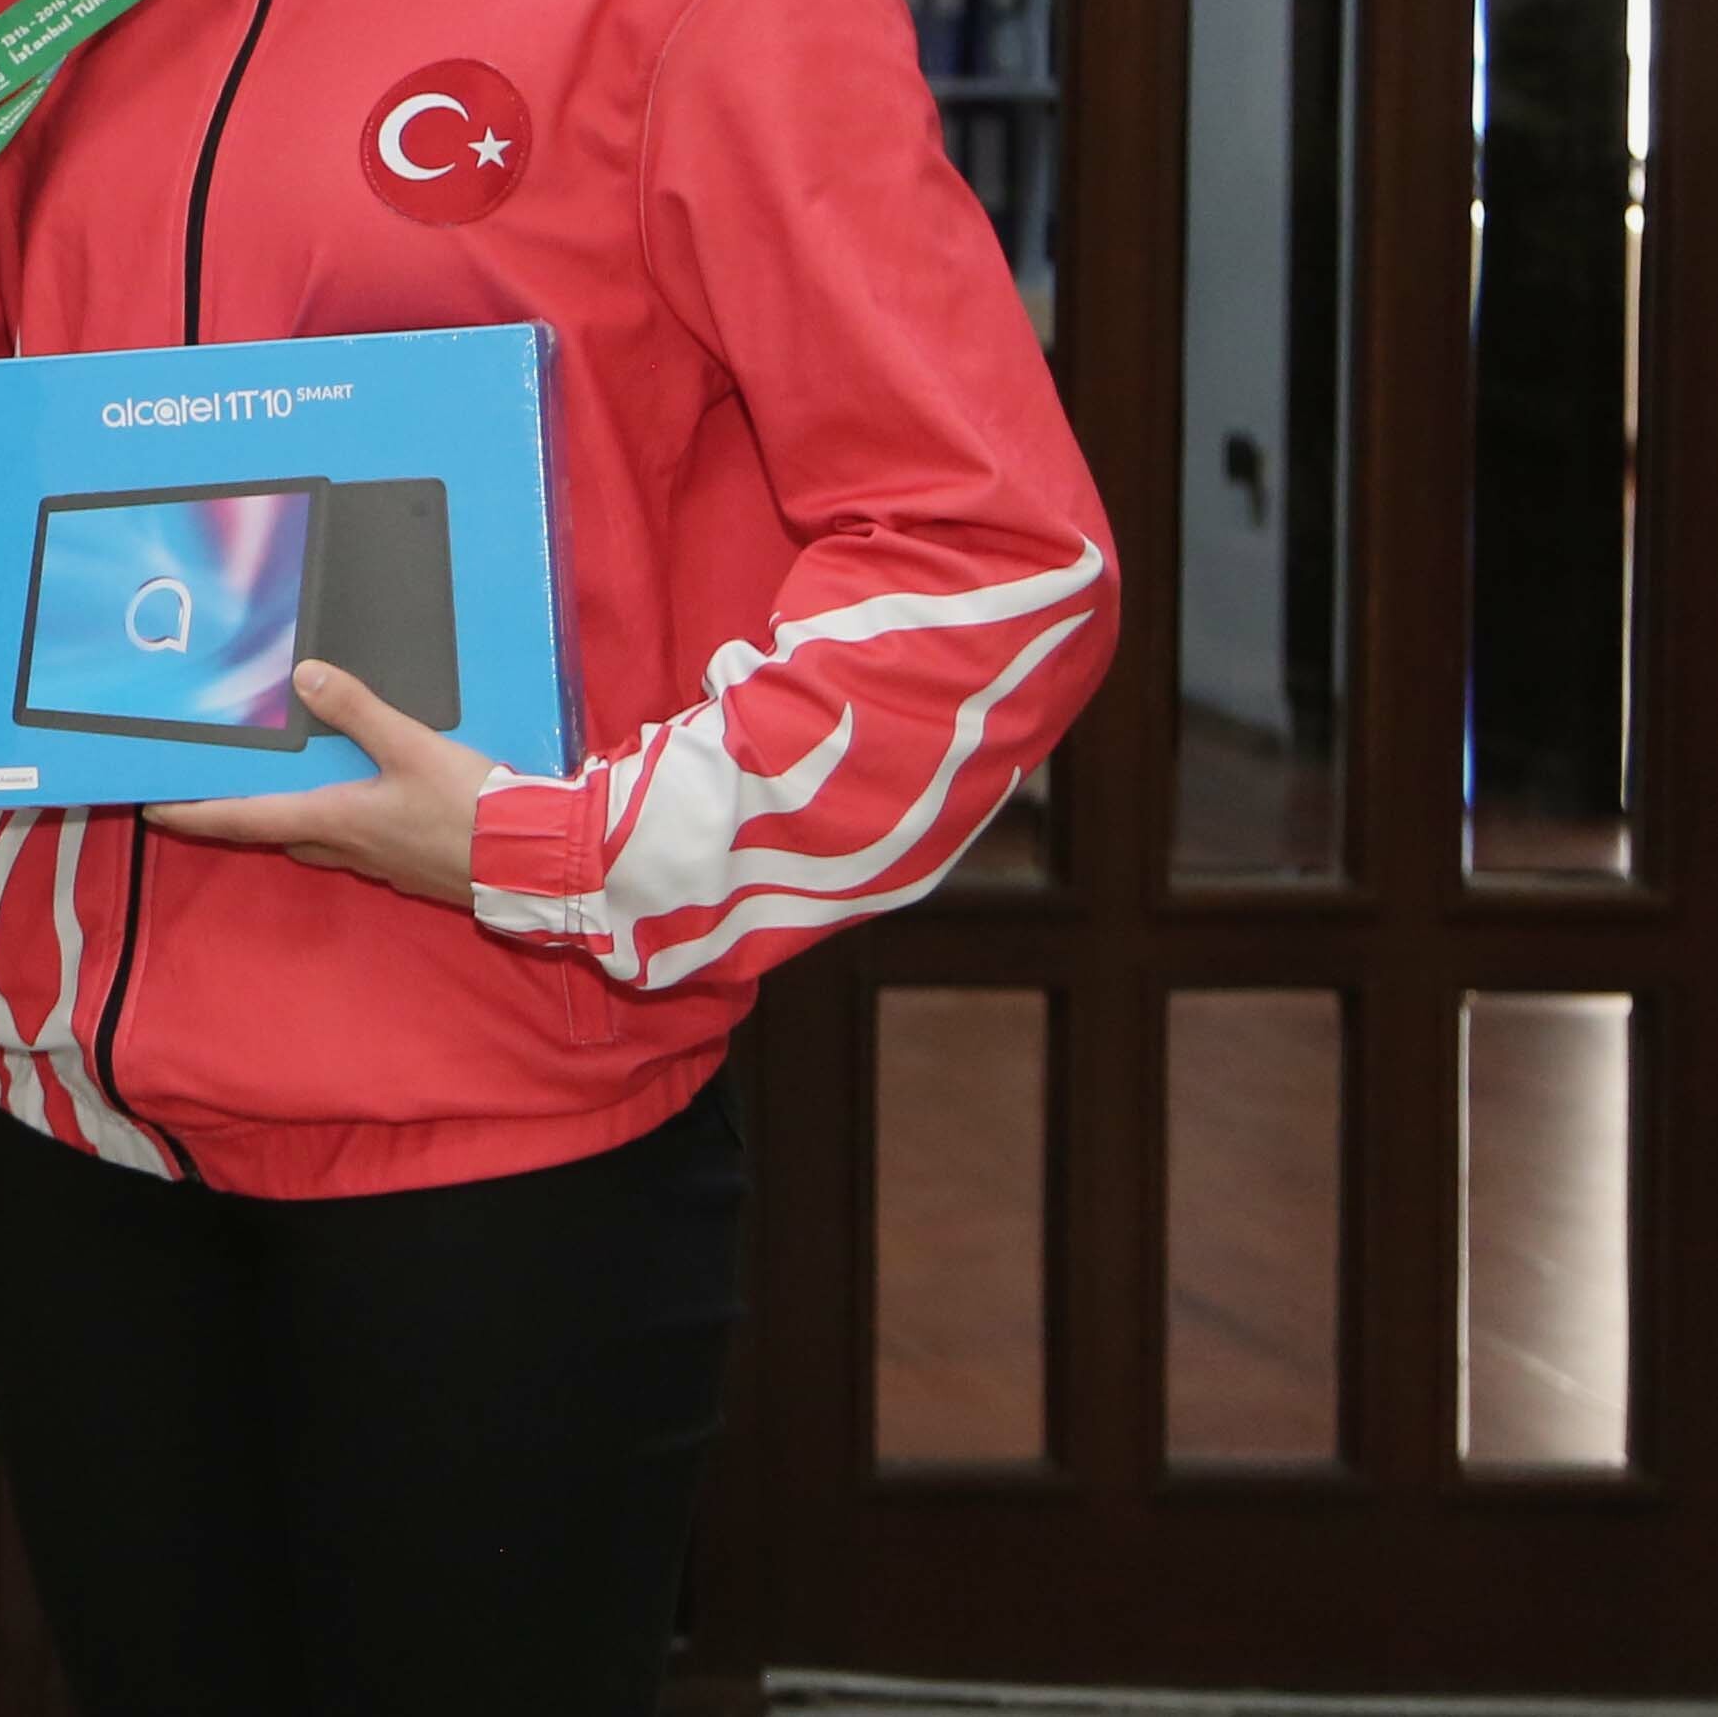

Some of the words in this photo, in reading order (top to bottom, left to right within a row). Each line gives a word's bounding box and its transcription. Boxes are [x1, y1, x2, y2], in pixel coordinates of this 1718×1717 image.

[102, 392, 220, 428] alcatel
[224, 388, 292, 421] 1T10
[296, 383, 354, 402] SMART
